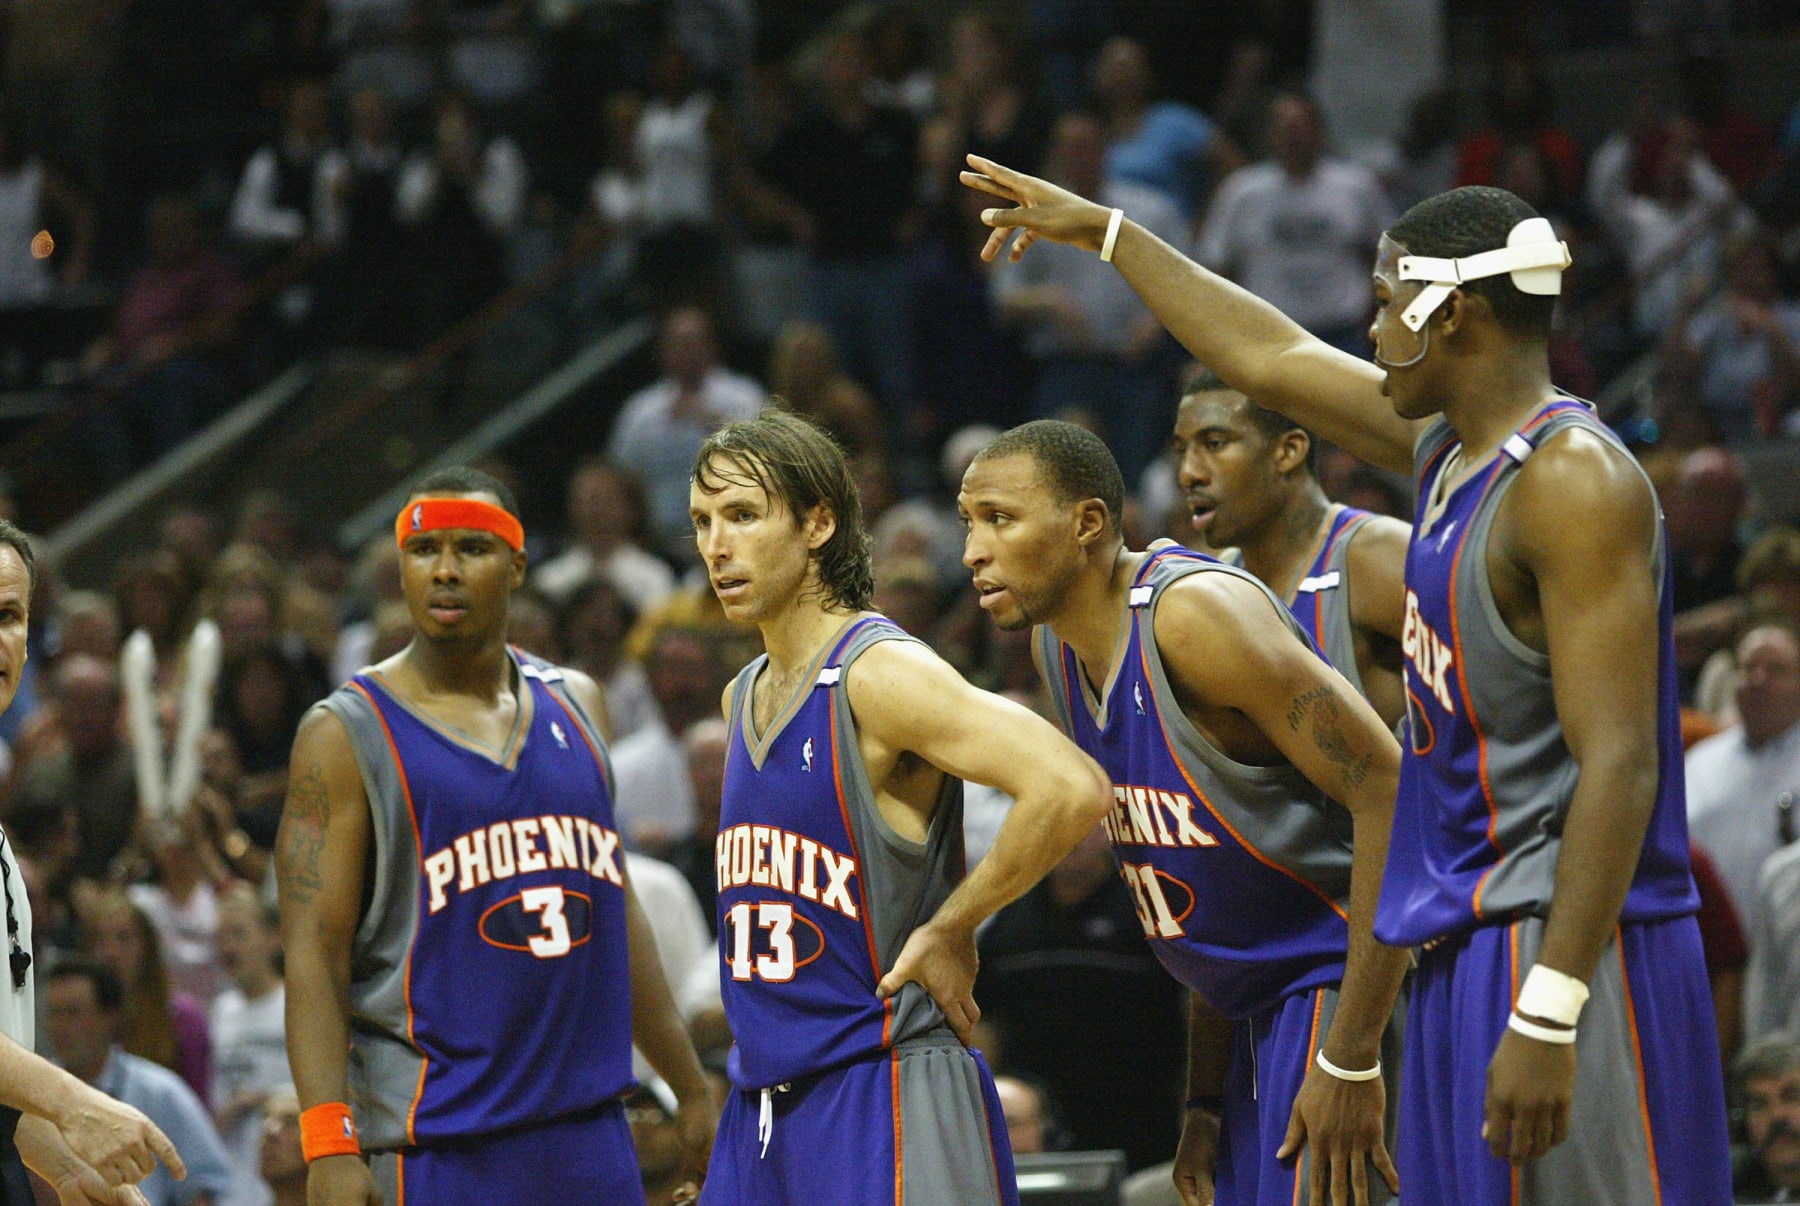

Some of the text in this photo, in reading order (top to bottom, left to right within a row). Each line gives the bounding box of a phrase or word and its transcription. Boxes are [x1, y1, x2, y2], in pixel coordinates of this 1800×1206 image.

[423, 814, 624, 916] PHOENIX
[1122, 861, 1187, 939] 31
[519, 884, 571, 958] 3
[731, 901, 797, 982] 13
